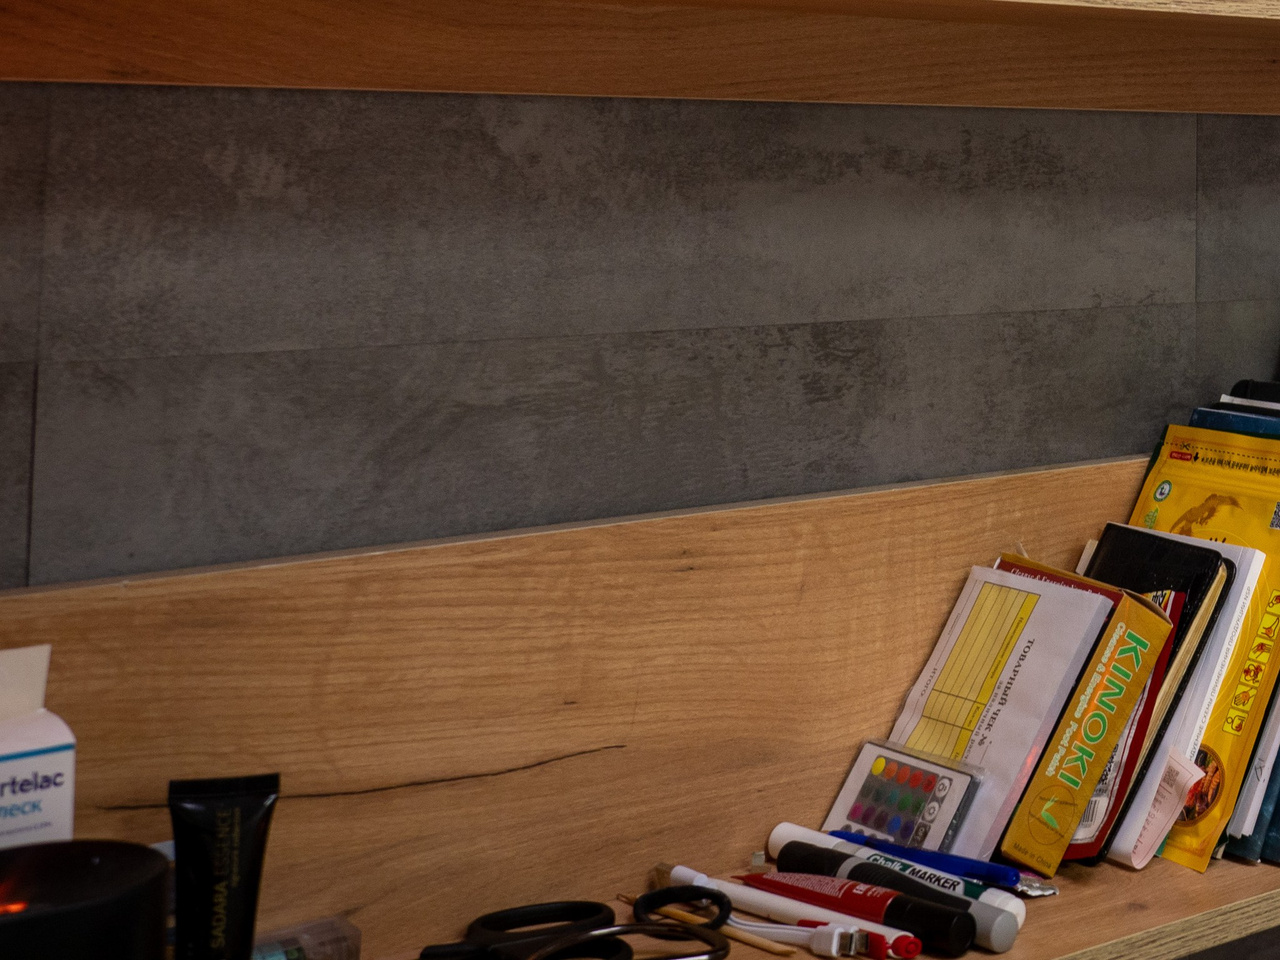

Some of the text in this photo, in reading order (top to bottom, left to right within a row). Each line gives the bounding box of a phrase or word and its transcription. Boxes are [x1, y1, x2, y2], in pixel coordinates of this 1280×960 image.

[986, 638, 1036, 733] ТОВАРНЫЙ ЧЕК
[1057, 629, 1151, 790] KINOKI
[869, 854, 961, 892] Chalk MARKER
